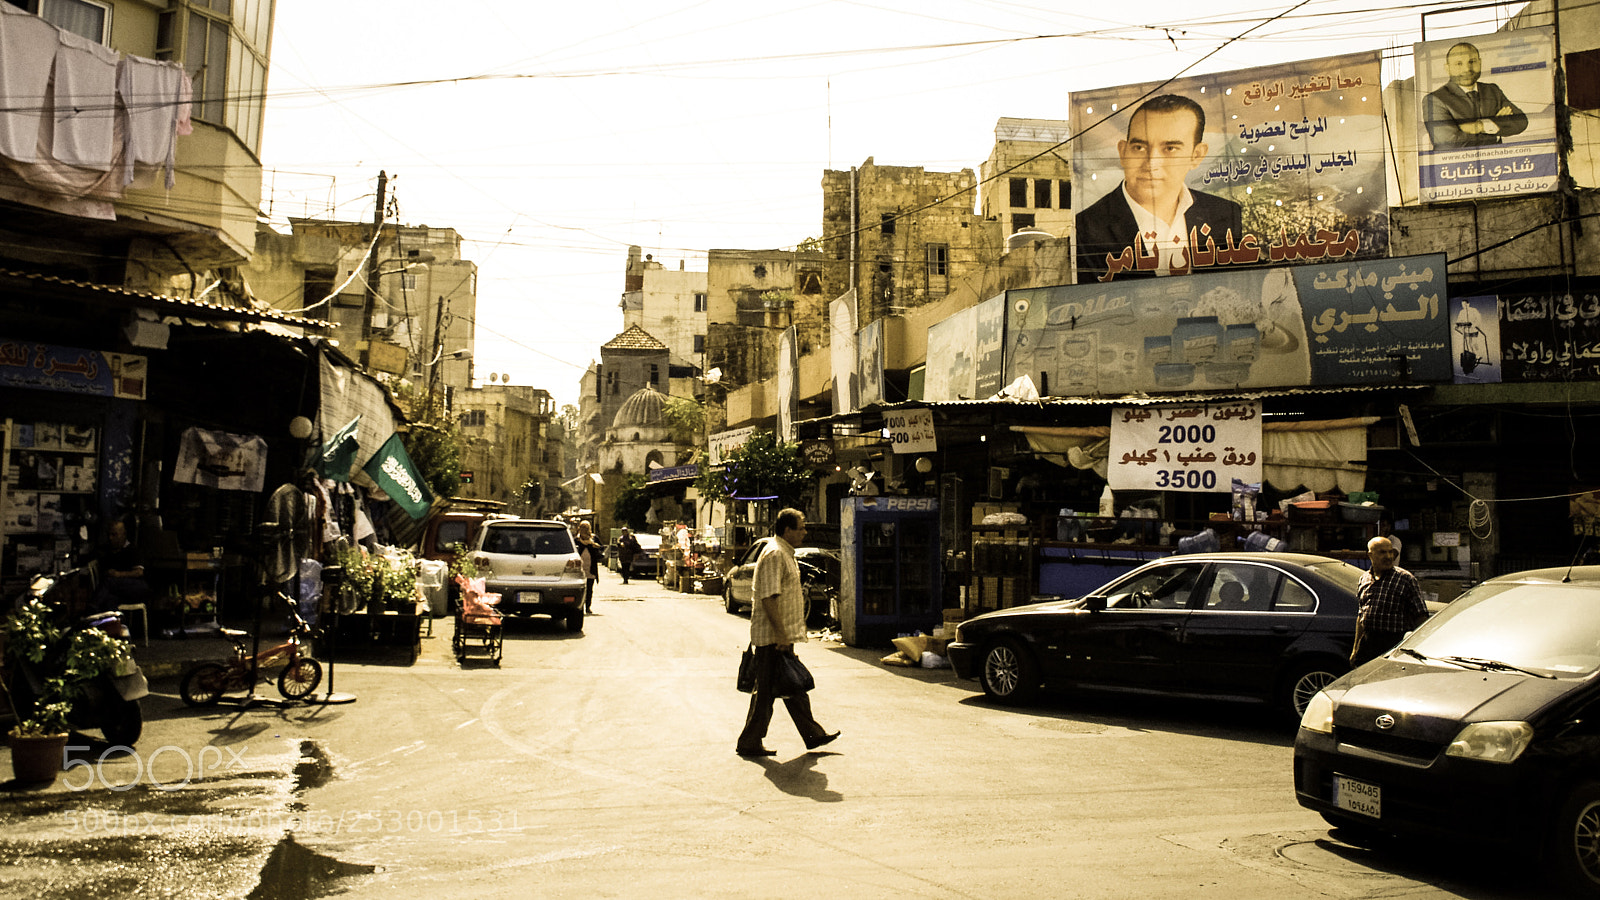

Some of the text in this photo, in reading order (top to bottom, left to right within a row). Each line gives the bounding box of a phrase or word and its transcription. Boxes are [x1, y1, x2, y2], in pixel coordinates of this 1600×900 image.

[1243, 84, 1284, 105] الواقع
[1290, 76, 1332, 99] لتغيير
[1239, 117, 1328, 141] المرشح لعضوية
[1441, 147, 1532, 161] www.chadinachabe.com
[1203, 150, 1357, 184] المجلس البلدي في طرابلس
[1440, 158, 1535, 181] شادي نشابة
[1429, 187, 1474, 200] طرابلس
[1514, 180, 1549, 192] مرشح
[1097, 222, 1360, 283] محمد عدنان تامر
[1313, 267, 1378, 294] ماركت
[1311, 293, 1439, 344] الديري
[34, 343, 98, 380] زهرة
[1122, 408, 1152, 423] كيلو
[1213, 403, 1256, 420] زيتون
[1158, 424, 1216, 444] 2000
[1118, 448, 1158, 466] كيلو
[1177, 447, 1217, 467] عنب
[1222, 446, 1257, 466] ورق
[1155, 469, 1217, 489] 3500
[887, 497, 932, 511] PEPSI
